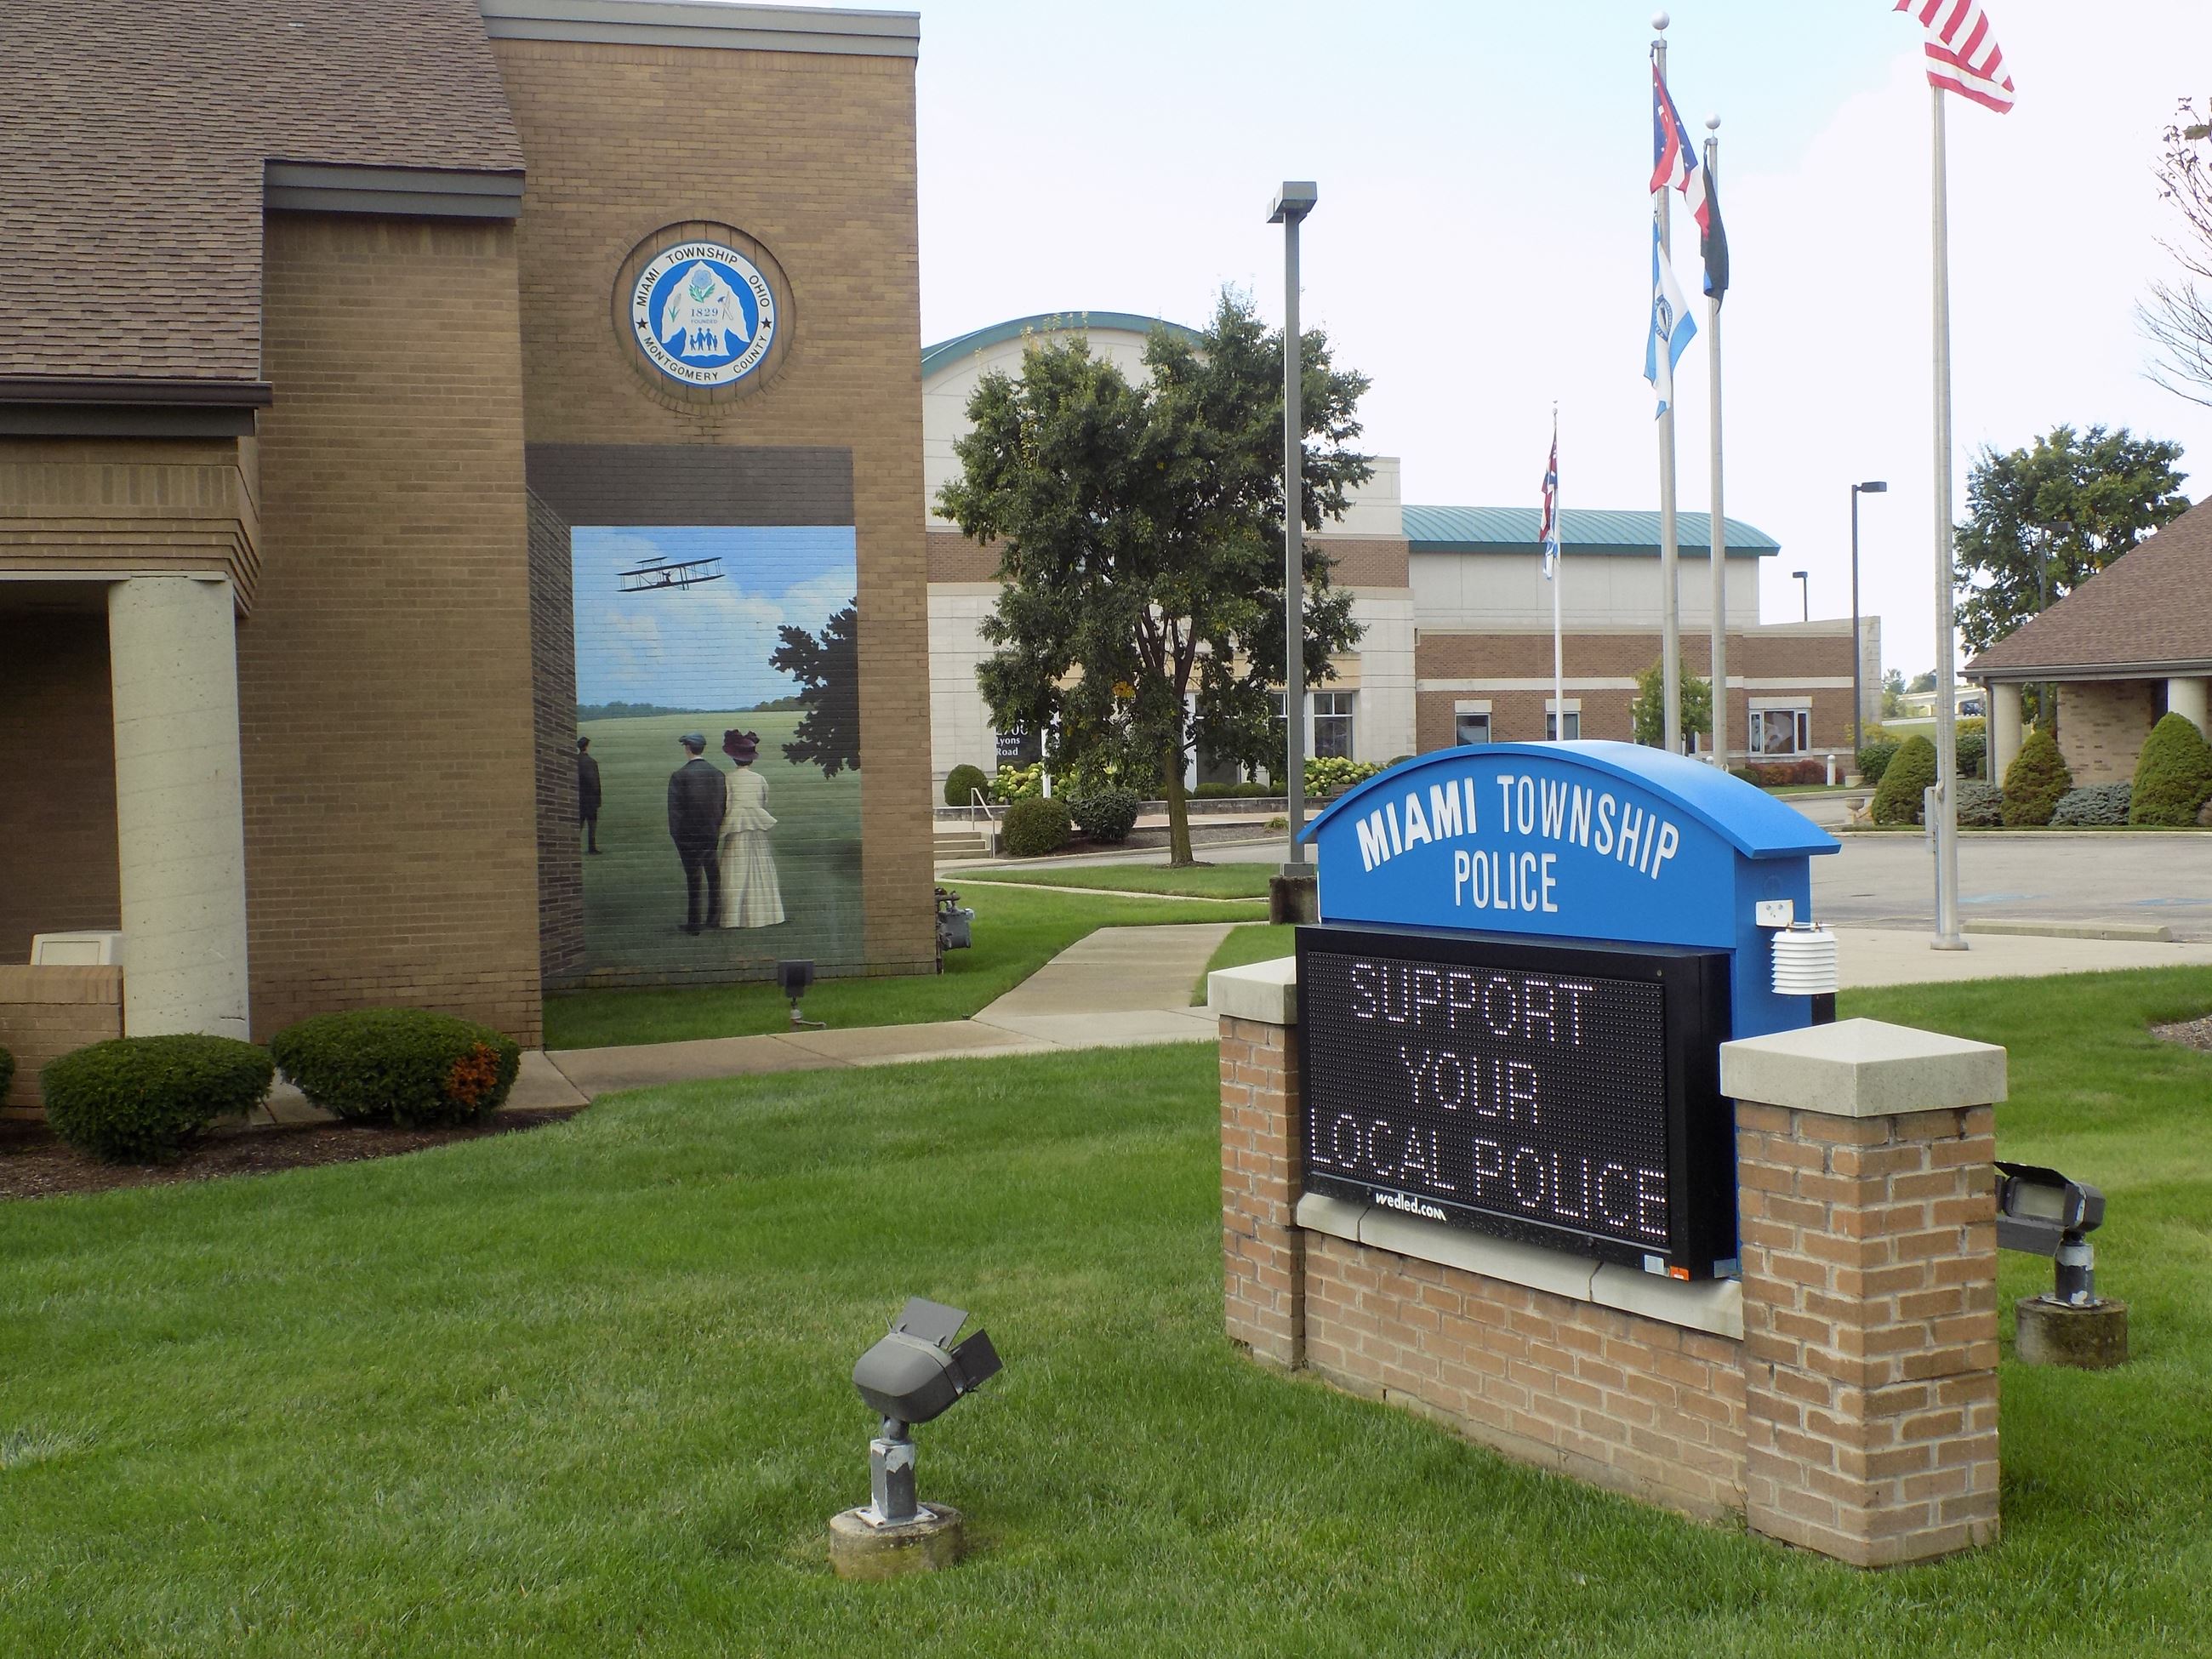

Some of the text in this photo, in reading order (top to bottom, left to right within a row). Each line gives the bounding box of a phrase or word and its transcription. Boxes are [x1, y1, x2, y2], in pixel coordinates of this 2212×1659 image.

[636, 247, 770, 307] MIAMI TOWNSHIP OHIO
[691, 308, 718, 317] 1829
[644, 335, 767, 381] MONTGOMERY COUNTY
[996, 737, 1020, 746] Lyons
[996, 747, 1018, 755] Road
[1356, 774, 1679, 880] MIAMI TOWNSHIP
[1455, 850, 1559, 913] POLICE
[1352, 963, 1593, 1046] SUPPORT
[1401, 1046, 1538, 1124] YOUR
[1311, 1108, 1666, 1236] LOCAL POLICE
[1376, 1193, 1446, 1221] wedled.com
